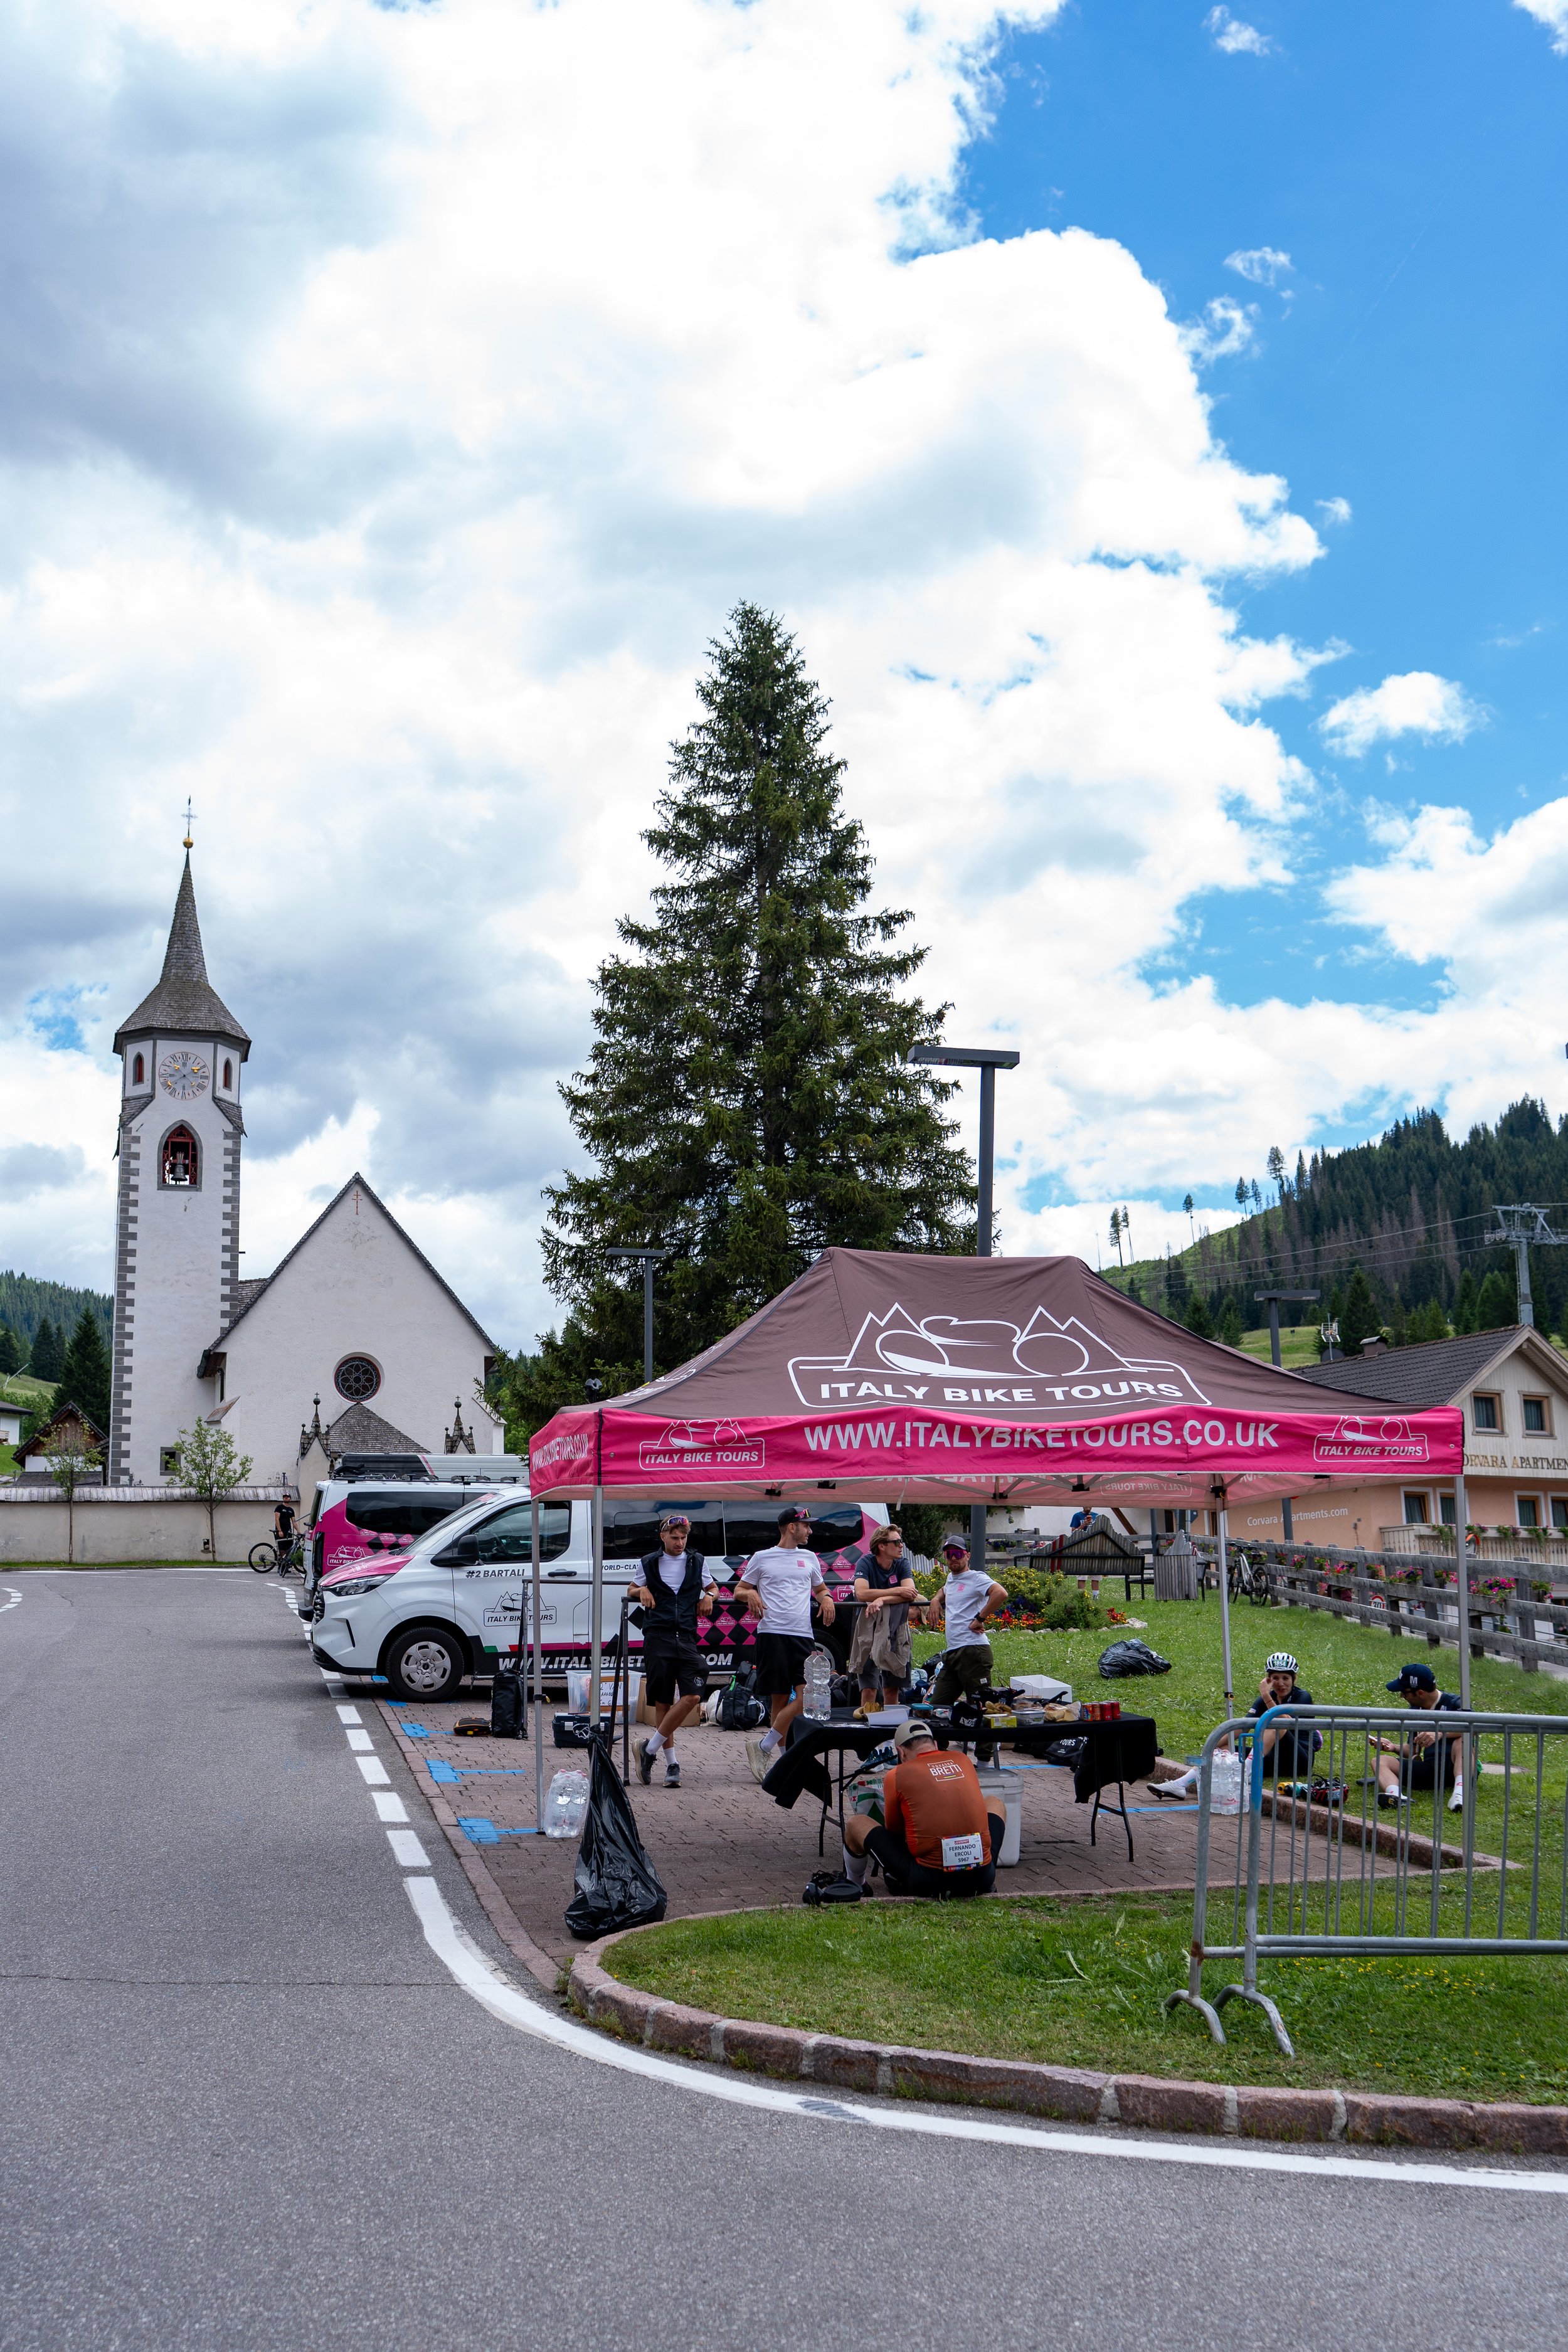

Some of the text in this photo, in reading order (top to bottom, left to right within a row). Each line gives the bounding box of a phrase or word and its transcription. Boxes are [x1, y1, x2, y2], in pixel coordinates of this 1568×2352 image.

[820, 1381, 1184, 1402] ITALY BIKE TOURS
[804, 1419, 1279, 1451] WWW.ITALYBIKETOURS.CO.UK
[645, 1451, 758, 1464] ITALY BIKE TOURS
[1319, 1446, 1423, 1456] ITALY BIKE TOURS
[1463, 1453, 1507, 1468] ORVARA
[1247, 1507, 1348, 1527] Corvara artments.com
[465, 1569, 525, 1578] #2 BARTALI
